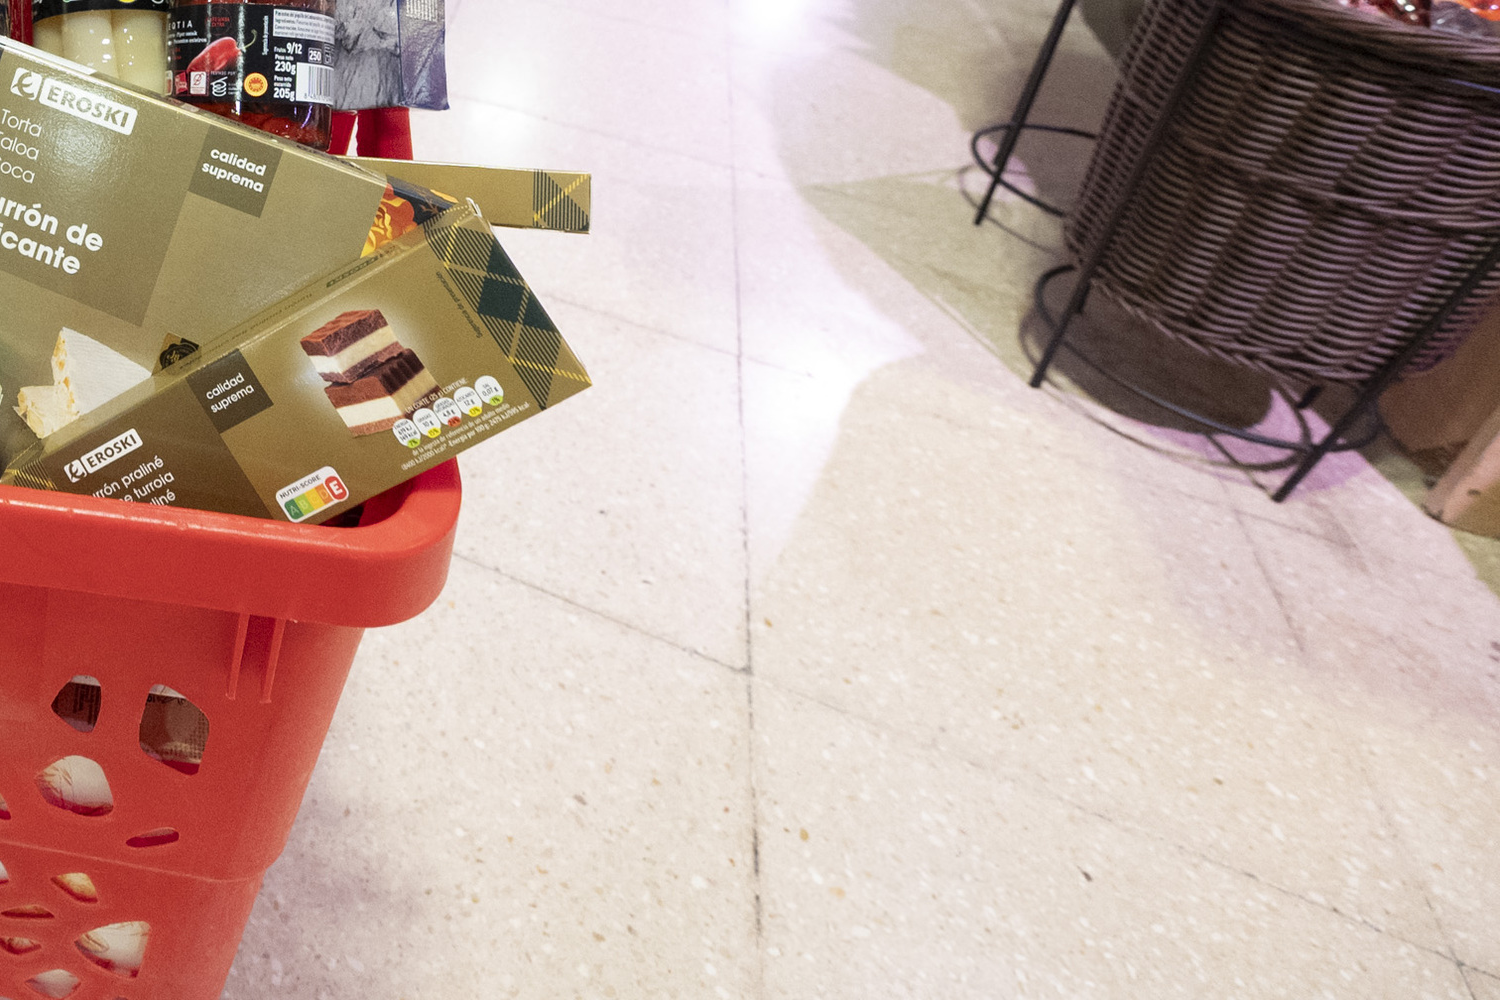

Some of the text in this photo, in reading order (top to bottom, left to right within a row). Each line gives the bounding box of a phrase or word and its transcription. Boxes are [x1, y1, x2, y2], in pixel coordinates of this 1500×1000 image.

[286, 42, 303, 54] 9/12
[309, 51, 321, 61] 250
[275, 61, 296, 75] 230g
[46, 86, 130, 129] EROSKI
[274, 87, 295, 102] 205g
[0, 108, 43, 139] Torta
[209, 146, 268, 177] calidad
[201, 161, 265, 195] suprema
[65, 221, 105, 253] de
[206, 372, 245, 400] calidad
[210, 384, 255, 413] suprema
[86, 433, 138, 468] EROSKI
[121, 454, 165, 490] praliné
[279, 474, 322, 500] NUTRI-SCORE
[332, 480, 343, 494] E
[132, 472, 176, 504] turroia
